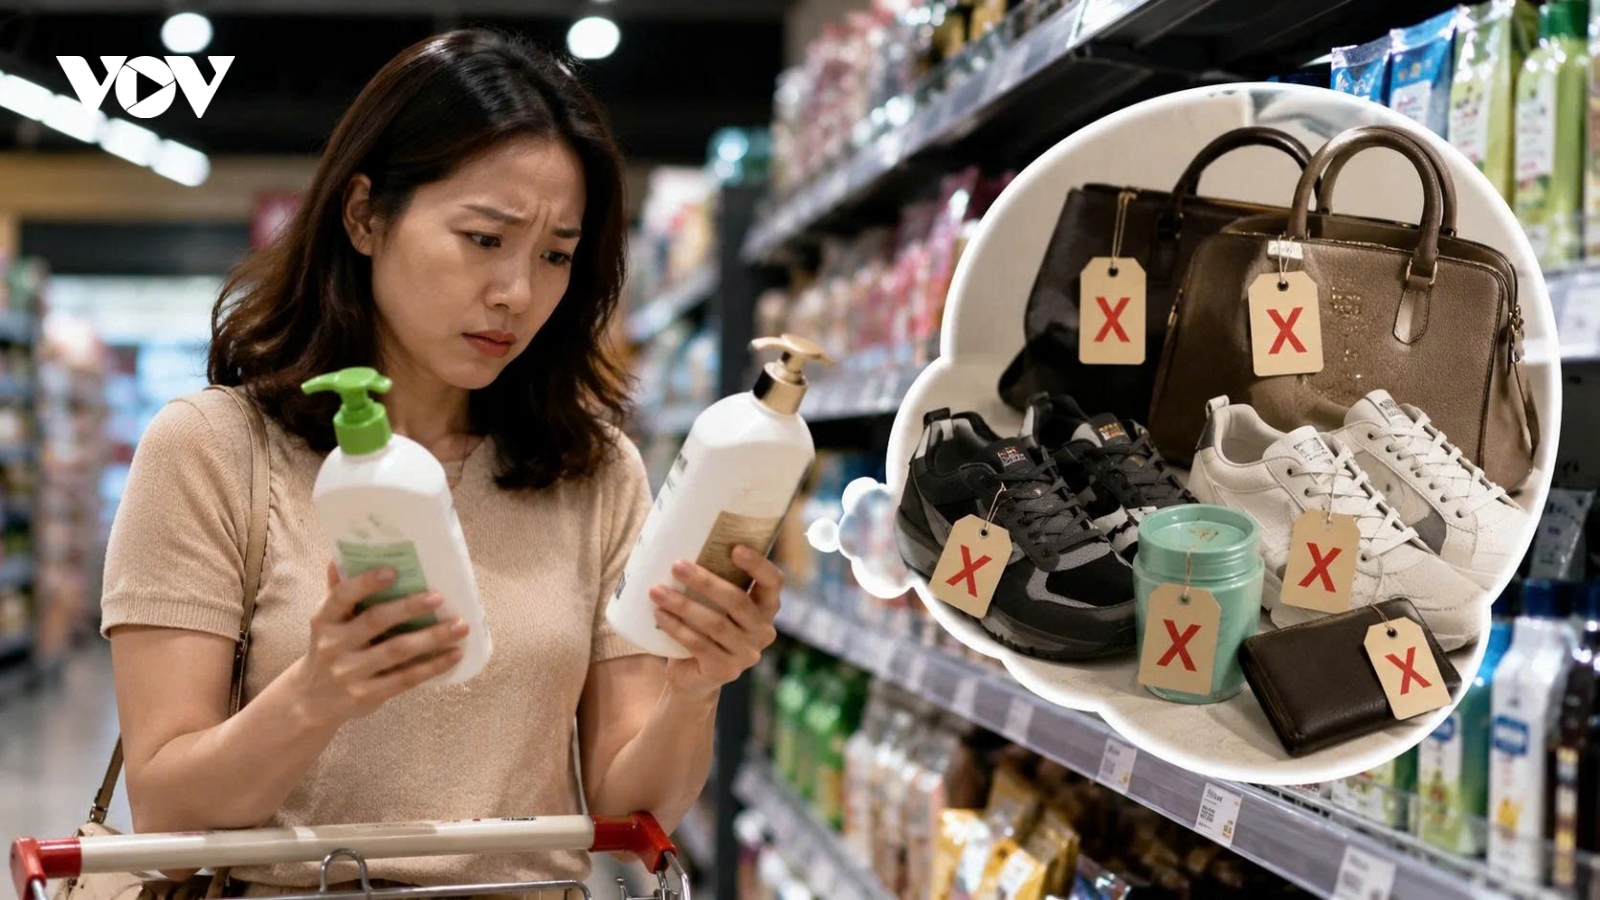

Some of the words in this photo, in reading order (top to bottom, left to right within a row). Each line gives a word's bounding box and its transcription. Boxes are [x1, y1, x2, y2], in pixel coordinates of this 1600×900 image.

[1094, 296, 1131, 343] X
[1266, 306, 1308, 355] X
[946, 544, 992, 597] X
[1299, 541, 1343, 593] X
[1156, 619, 1202, 672] X
[1385, 646, 1432, 695] X
